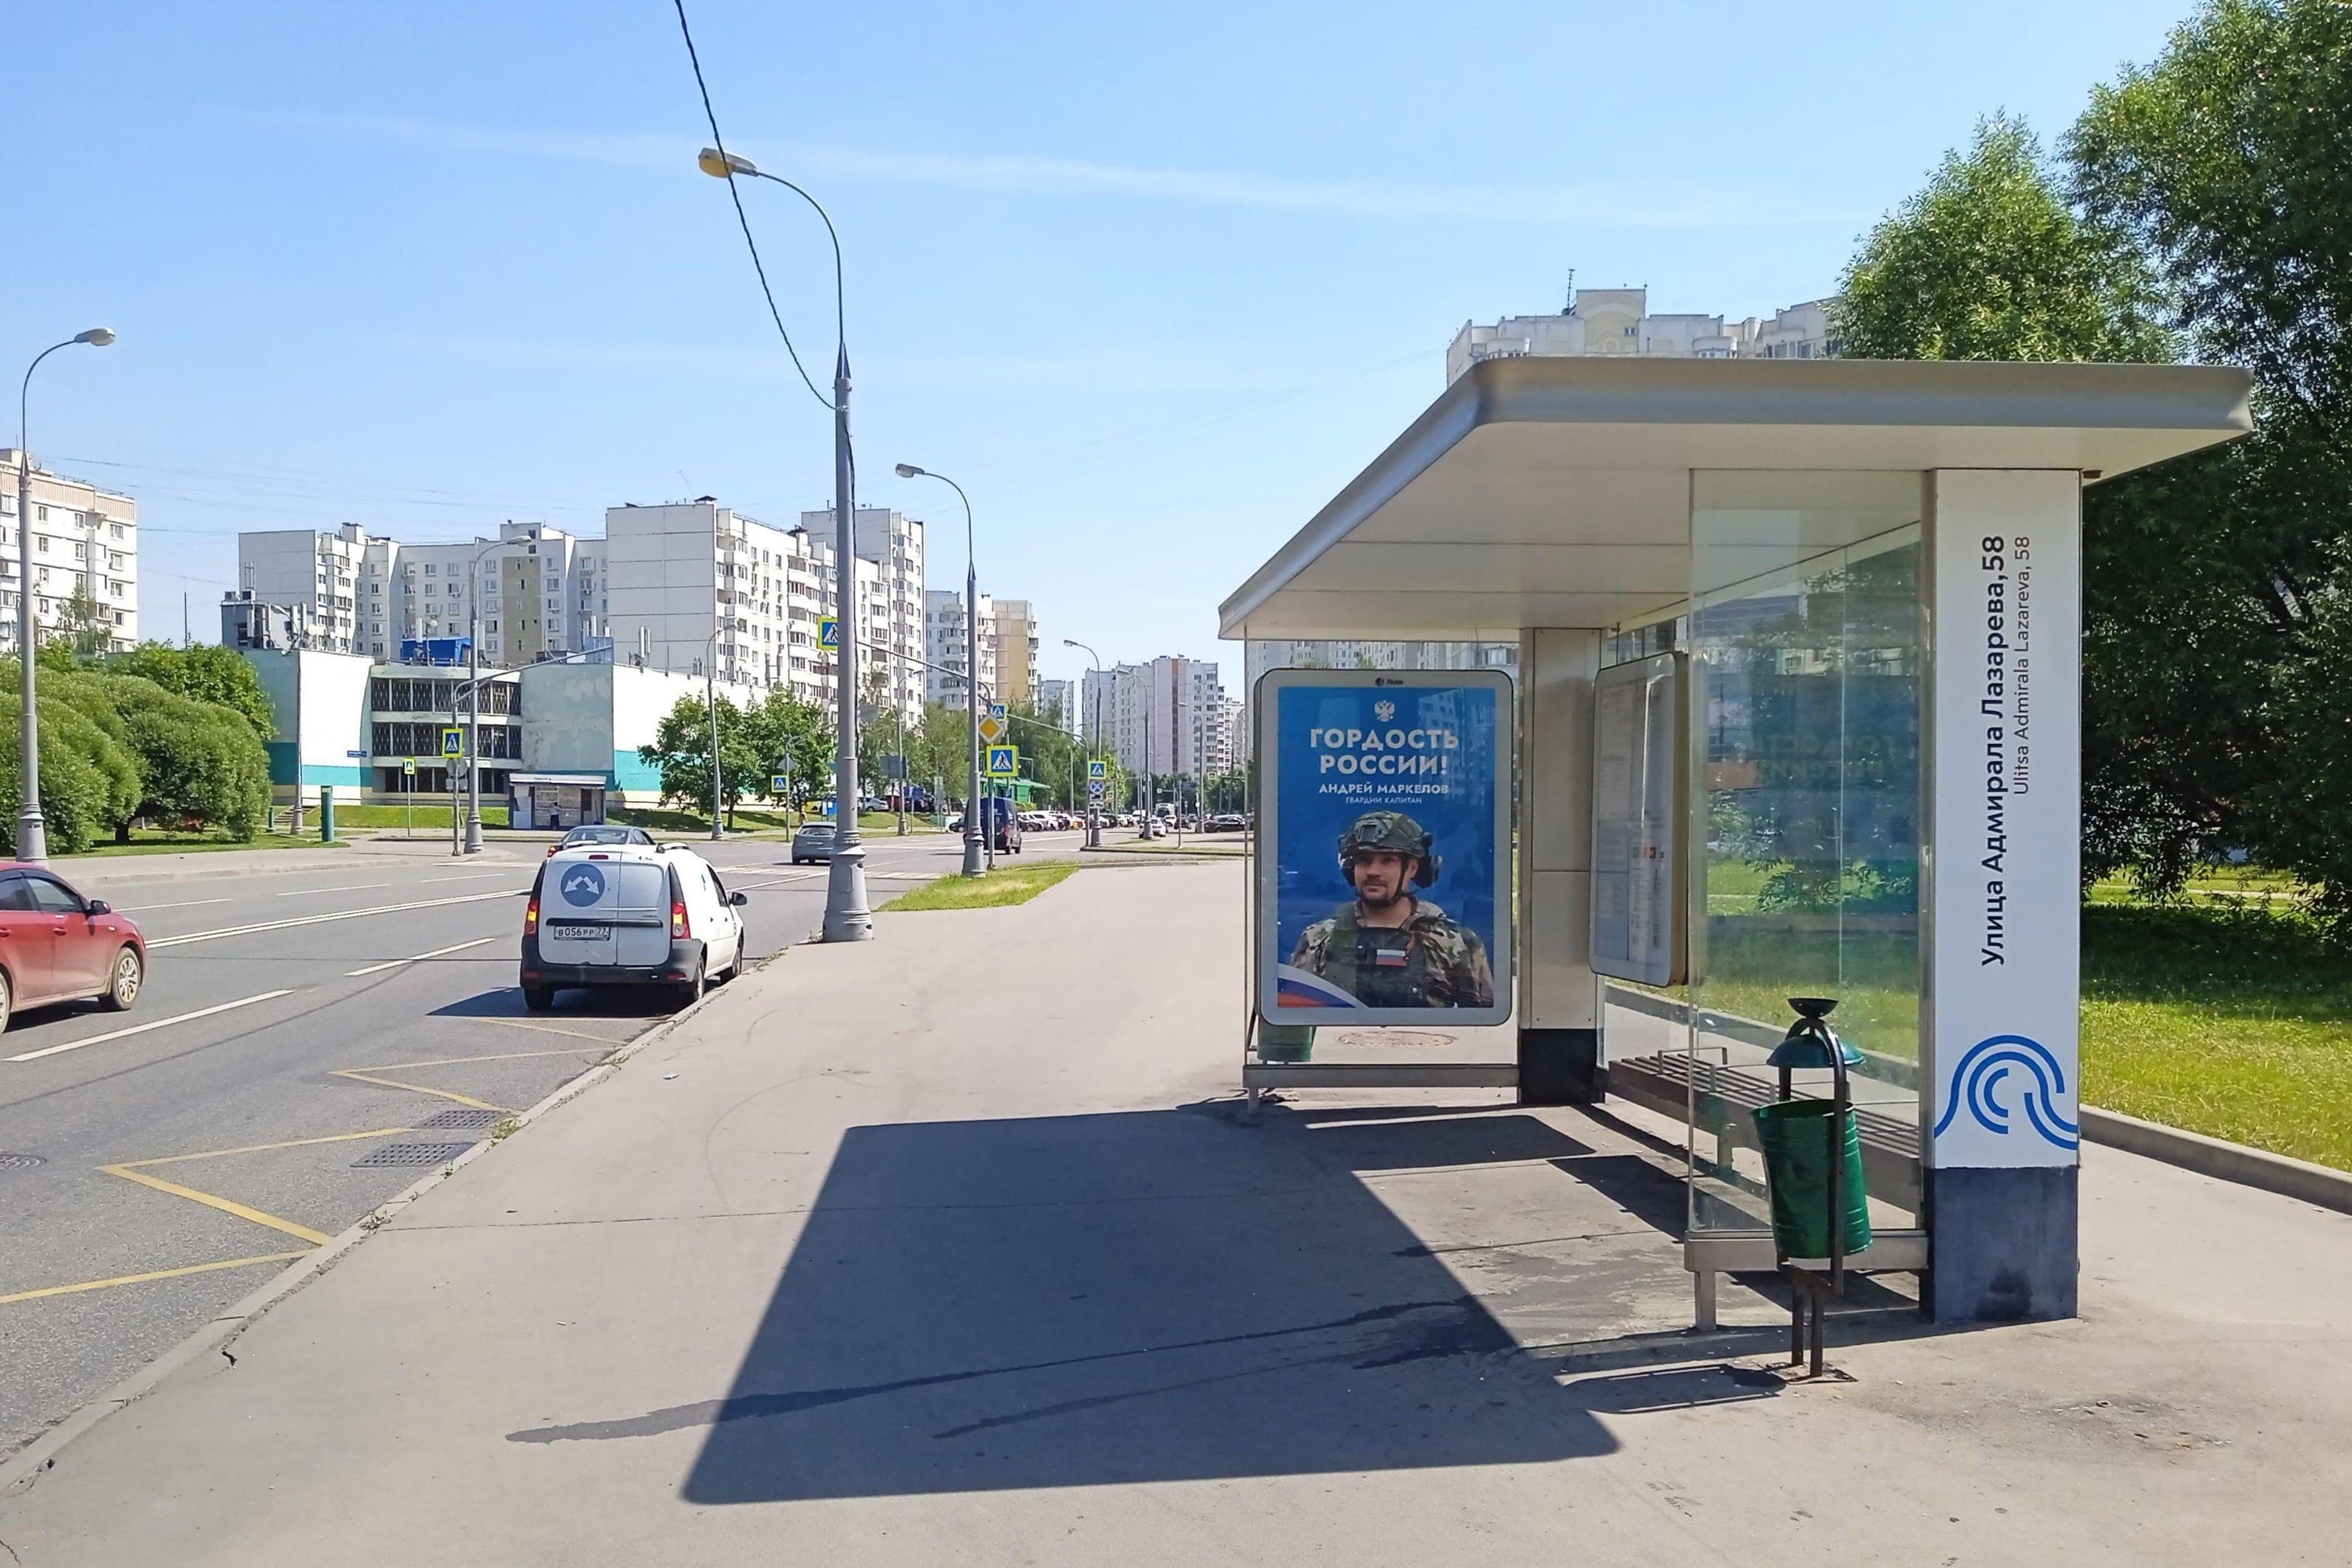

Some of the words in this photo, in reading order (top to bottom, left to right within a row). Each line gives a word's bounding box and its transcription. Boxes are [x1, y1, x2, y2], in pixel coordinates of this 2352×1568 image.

[2014, 536, 2030, 561] 58
[2014, 566, 2033, 652] Lazareva,
[2013, 657, 2029, 740] Admirala
[1310, 728, 1459, 751] ГОРДОСТЬ
[1320, 755, 1447, 776] РОССИИ!
[2013, 746, 2029, 795] Ulitsa
[1319, 781, 1373, 795] АНДРЕЙ
[1377, 784, 1449, 794] МАРКЕЛОВ
[1346, 796, 1382, 804] ГВАРДИИ
[1980, 726, 2009, 873] Адмирала
[1980, 880, 2007, 966] Улица
